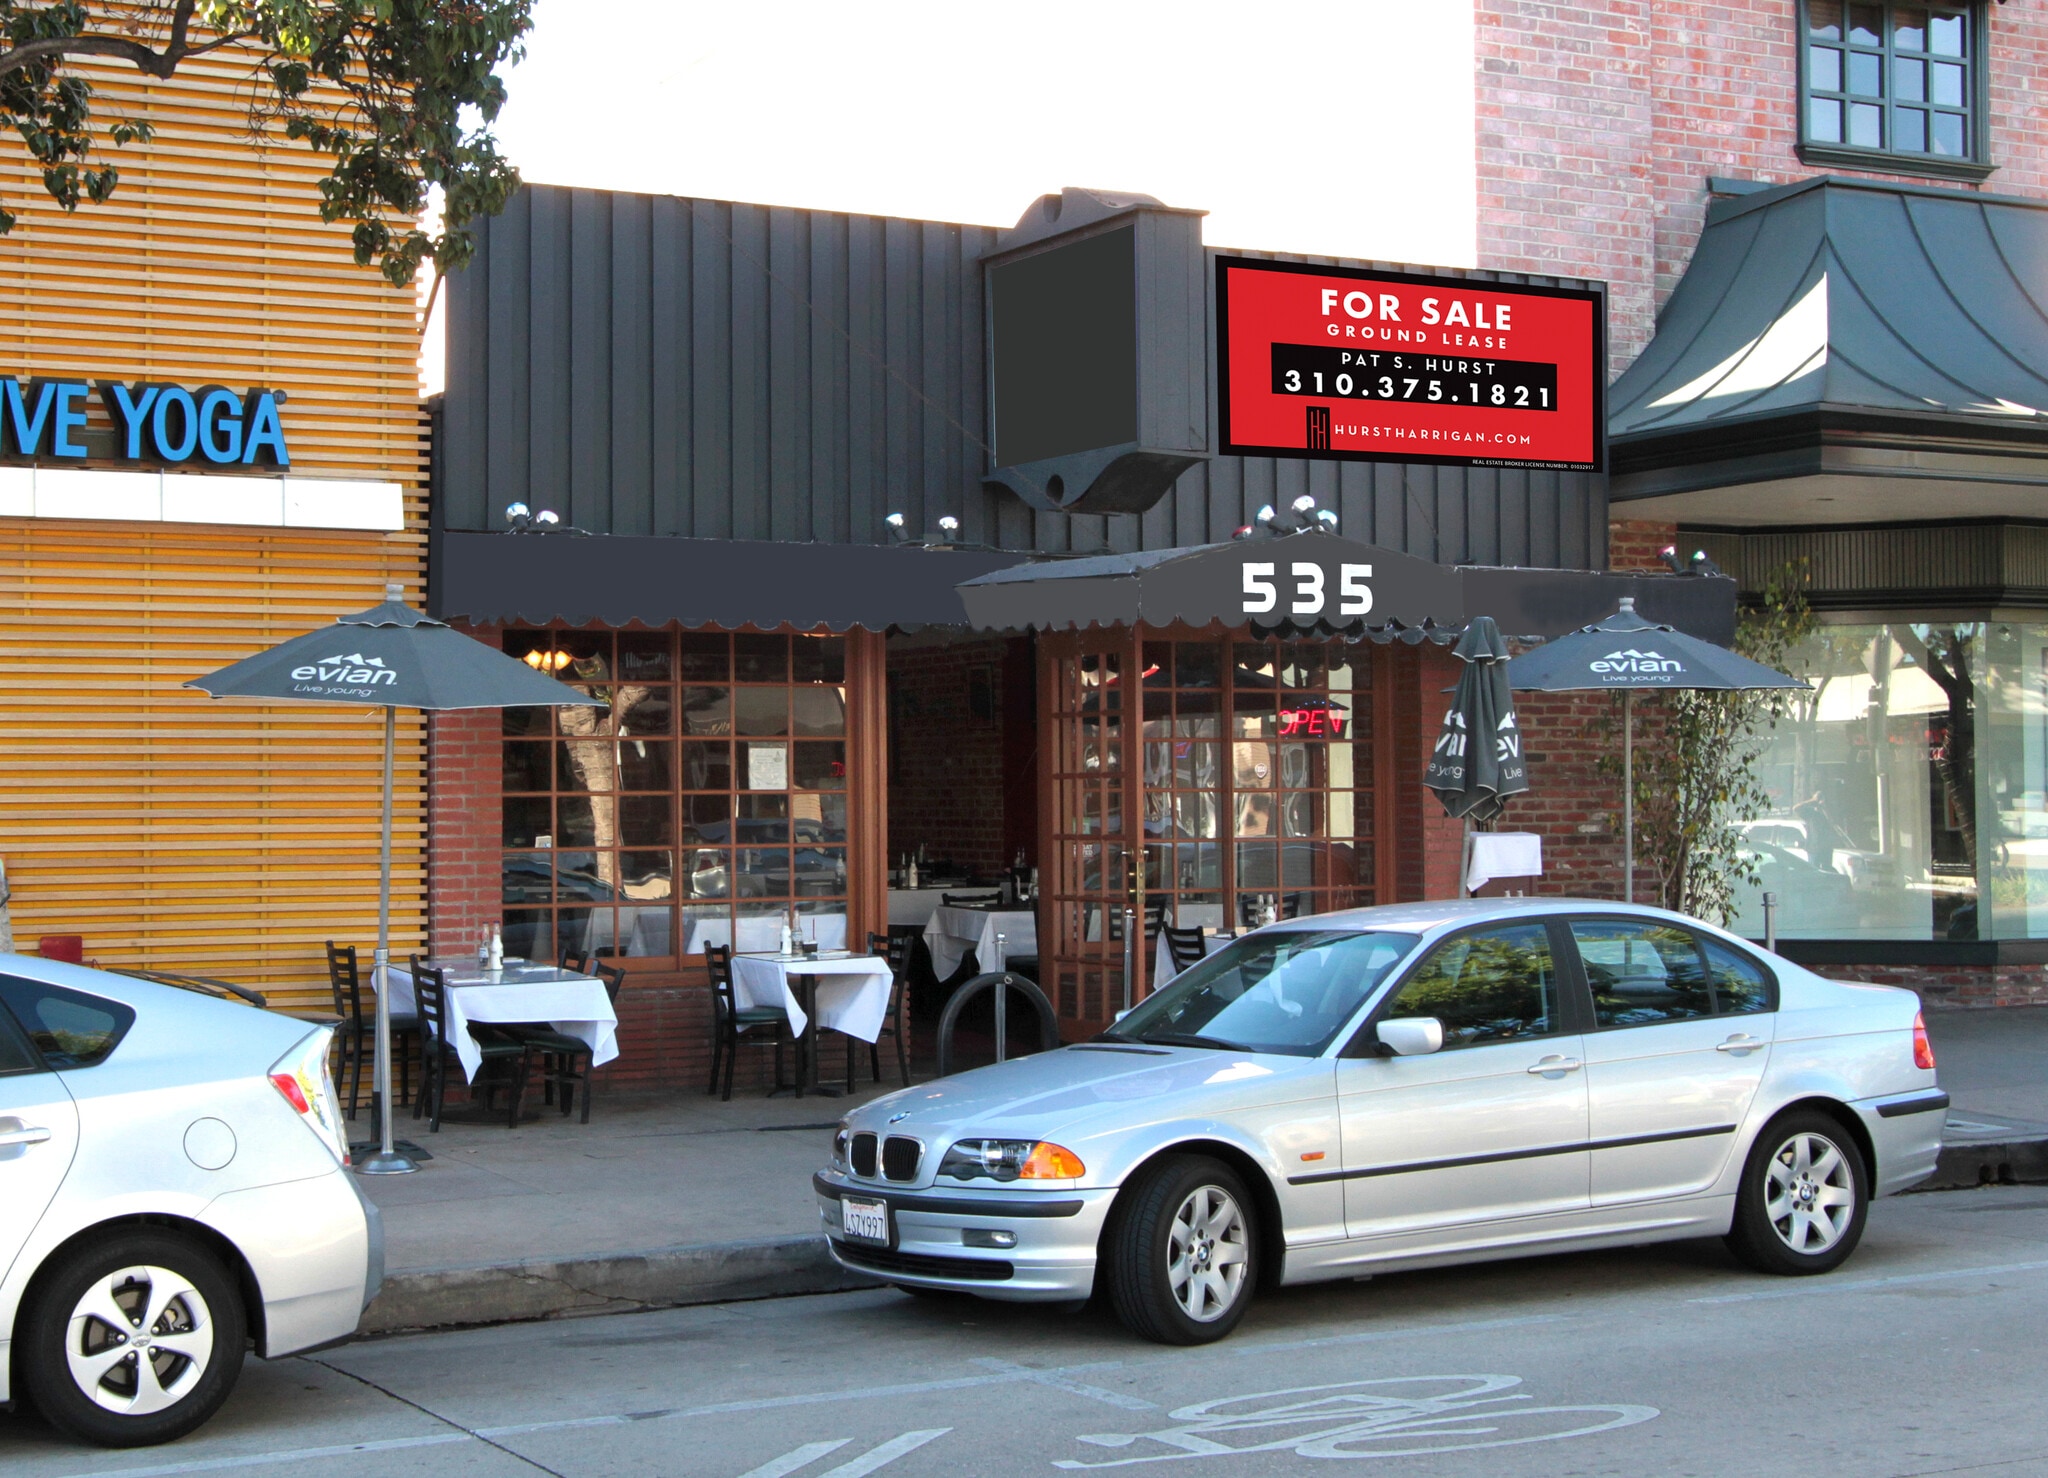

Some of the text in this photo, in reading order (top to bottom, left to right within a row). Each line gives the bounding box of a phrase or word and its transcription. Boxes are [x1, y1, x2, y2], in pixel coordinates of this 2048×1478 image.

[1321, 288, 1511, 331] FOR SALE
[1326, 323, 1507, 350] GROUND LEASE
[1341, 352, 1497, 375] PAT S. HURST
[1284, 369, 1549, 408] 310.375.1821
[0, 379, 89, 458] VE
[112, 384, 290, 466] YOGA
[1334, 424, 1531, 445] HURSTHARRIGAN.COM
[1242, 562, 1374, 615] 535
[291, 665, 397, 685] evian
[1590, 658, 1682, 673] evian
[294, 684, 323, 692] Live
[845, 1212, 883, 1239] 4SZY997
